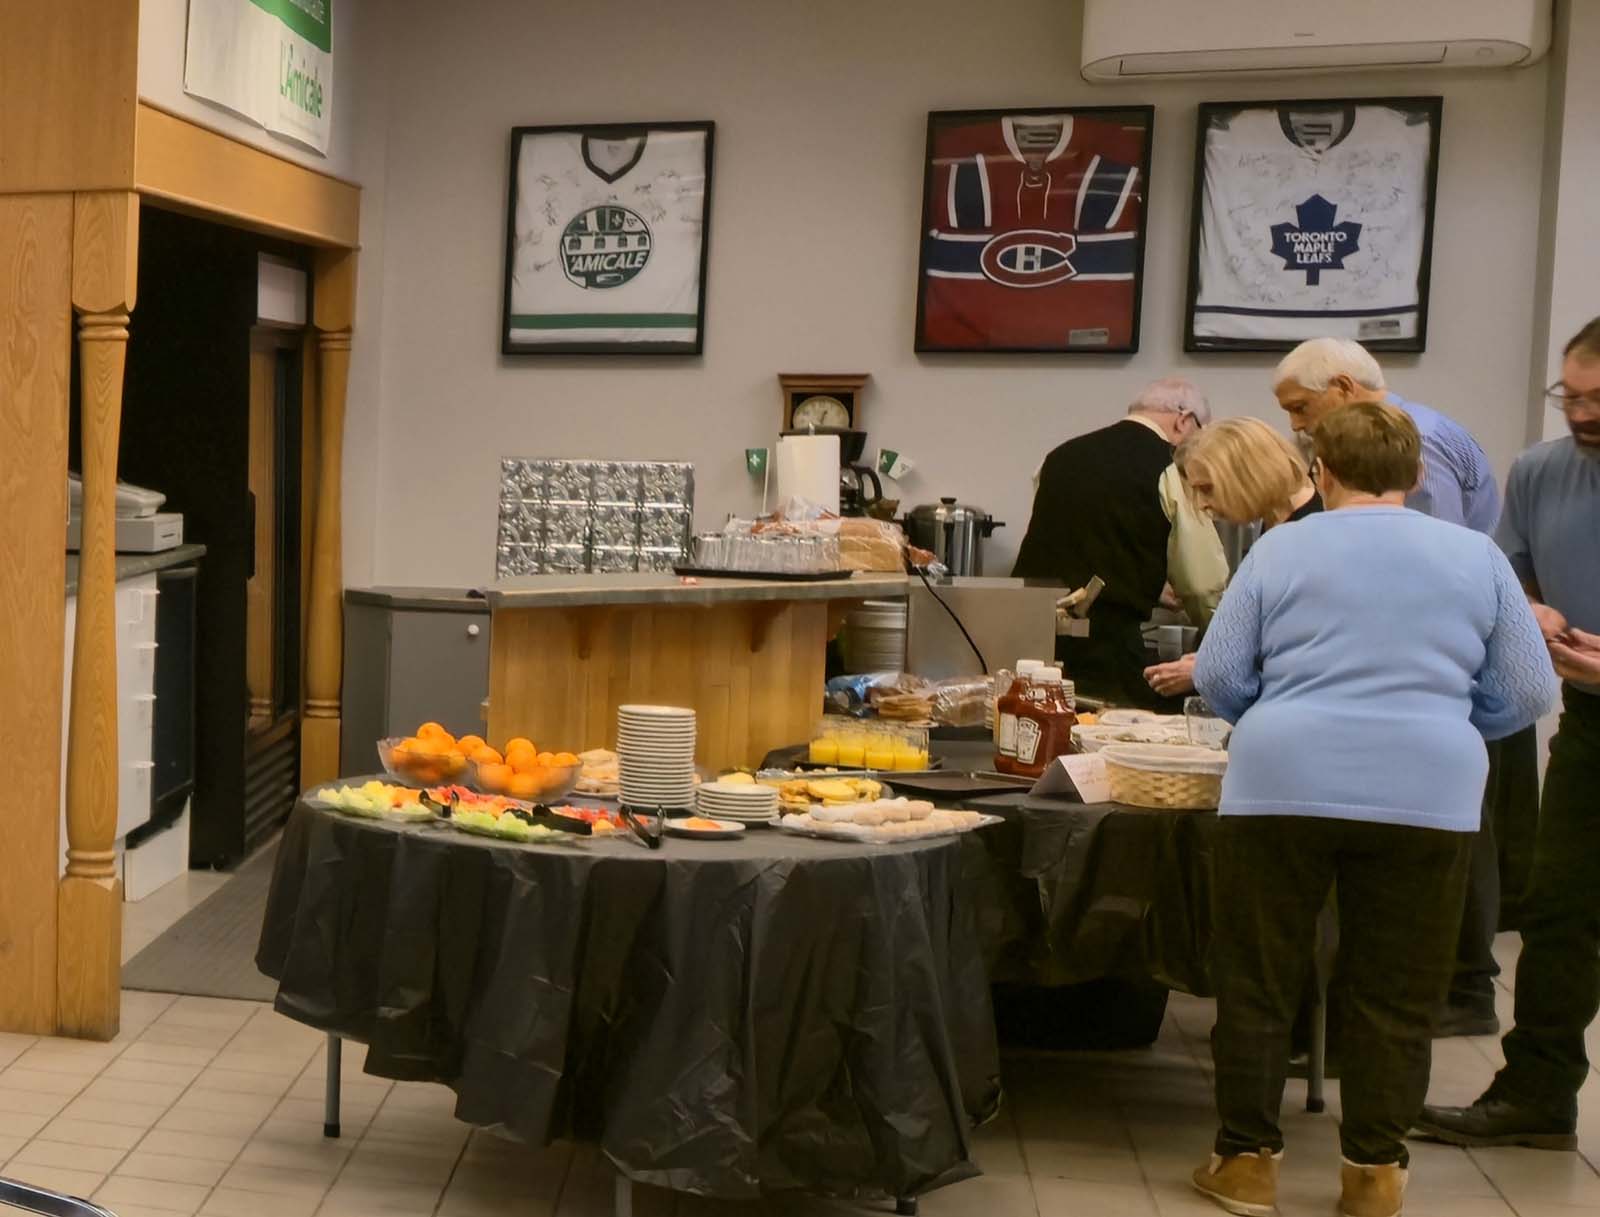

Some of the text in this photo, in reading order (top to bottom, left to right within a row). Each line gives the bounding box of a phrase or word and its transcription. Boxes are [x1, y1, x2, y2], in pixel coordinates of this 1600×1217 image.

[1284, 232, 1347, 243] TORONTO
[1293, 241, 1335, 253] MAPLE
[1296, 252, 1333, 264] LEAFS
